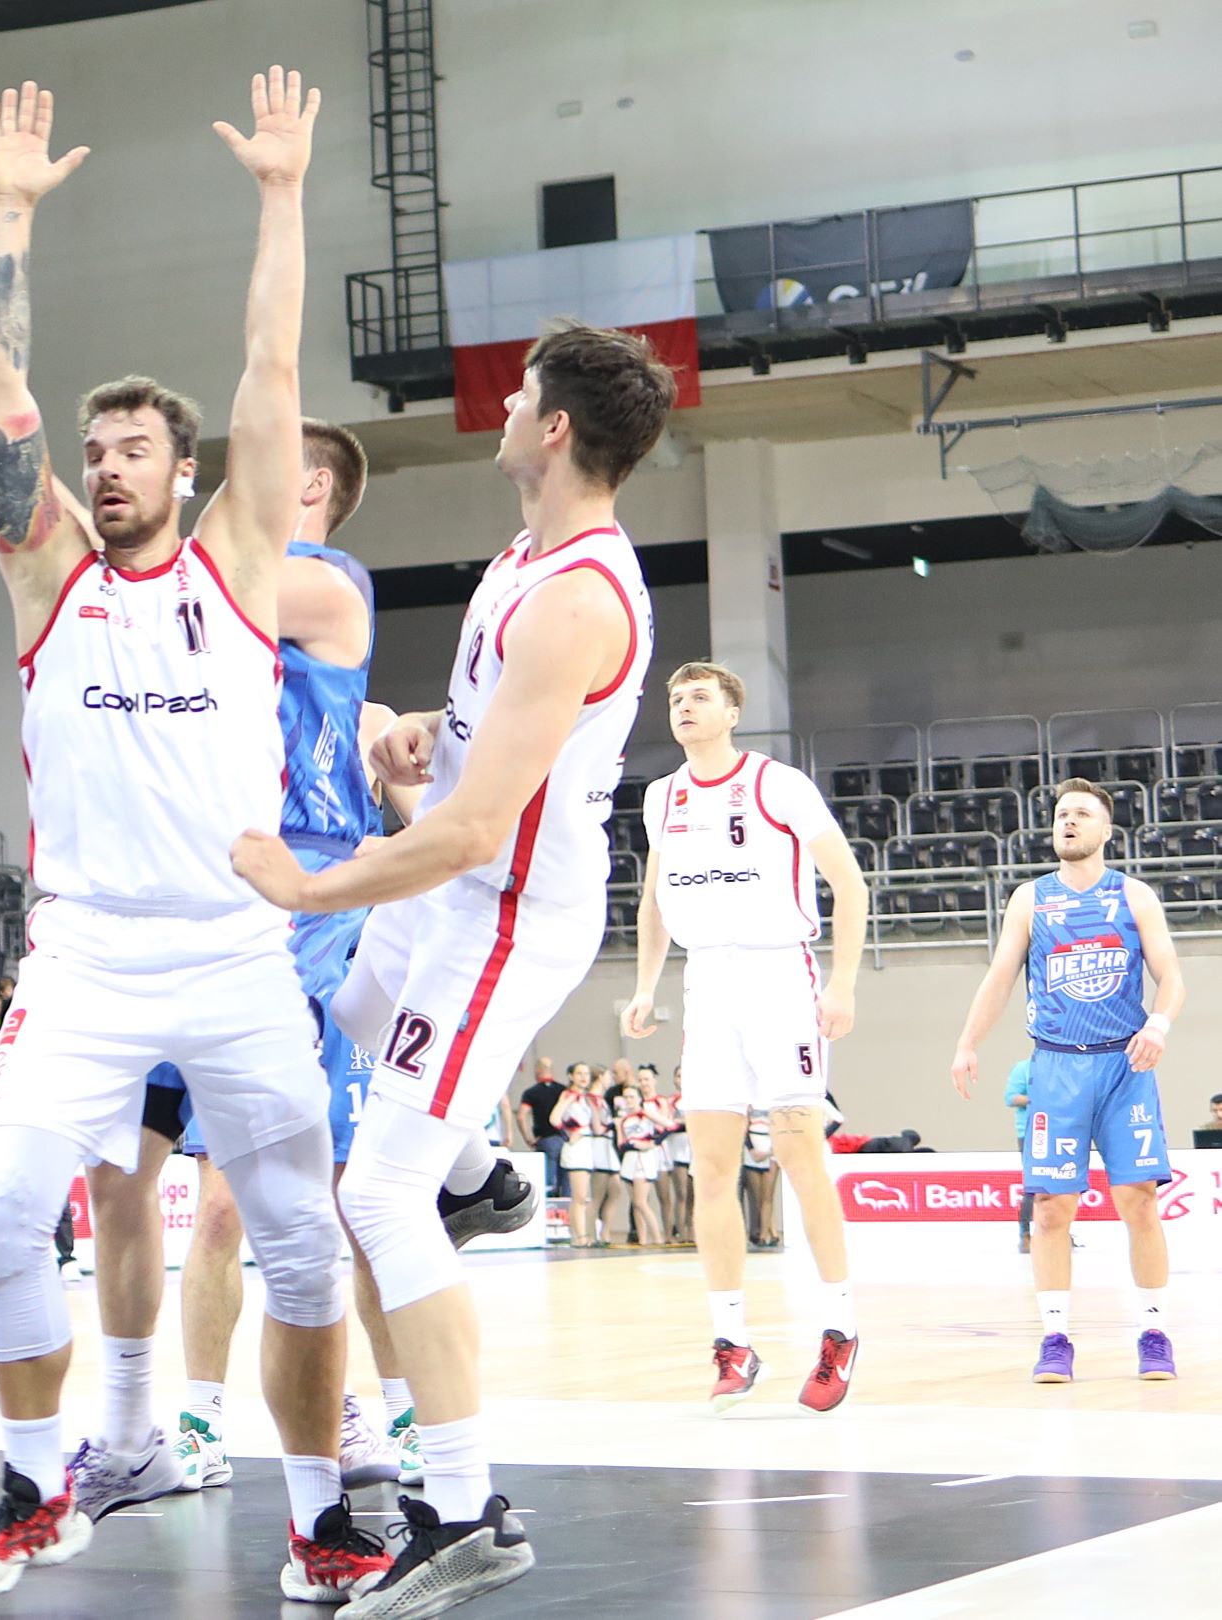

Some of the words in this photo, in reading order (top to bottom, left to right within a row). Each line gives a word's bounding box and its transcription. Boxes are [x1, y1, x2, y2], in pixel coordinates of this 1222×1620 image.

[728, 812, 747, 848] 5
[1101, 898, 1120, 922] 7
[1050, 951, 1127, 981] DECKA
[381, 1007, 438, 1080] 12
[794, 1042, 813, 1078] 5
[1133, 1129, 1153, 1157] 7
[162, 1178, 188, 1205] iga
[925, 1184, 1002, 1210] Bank
